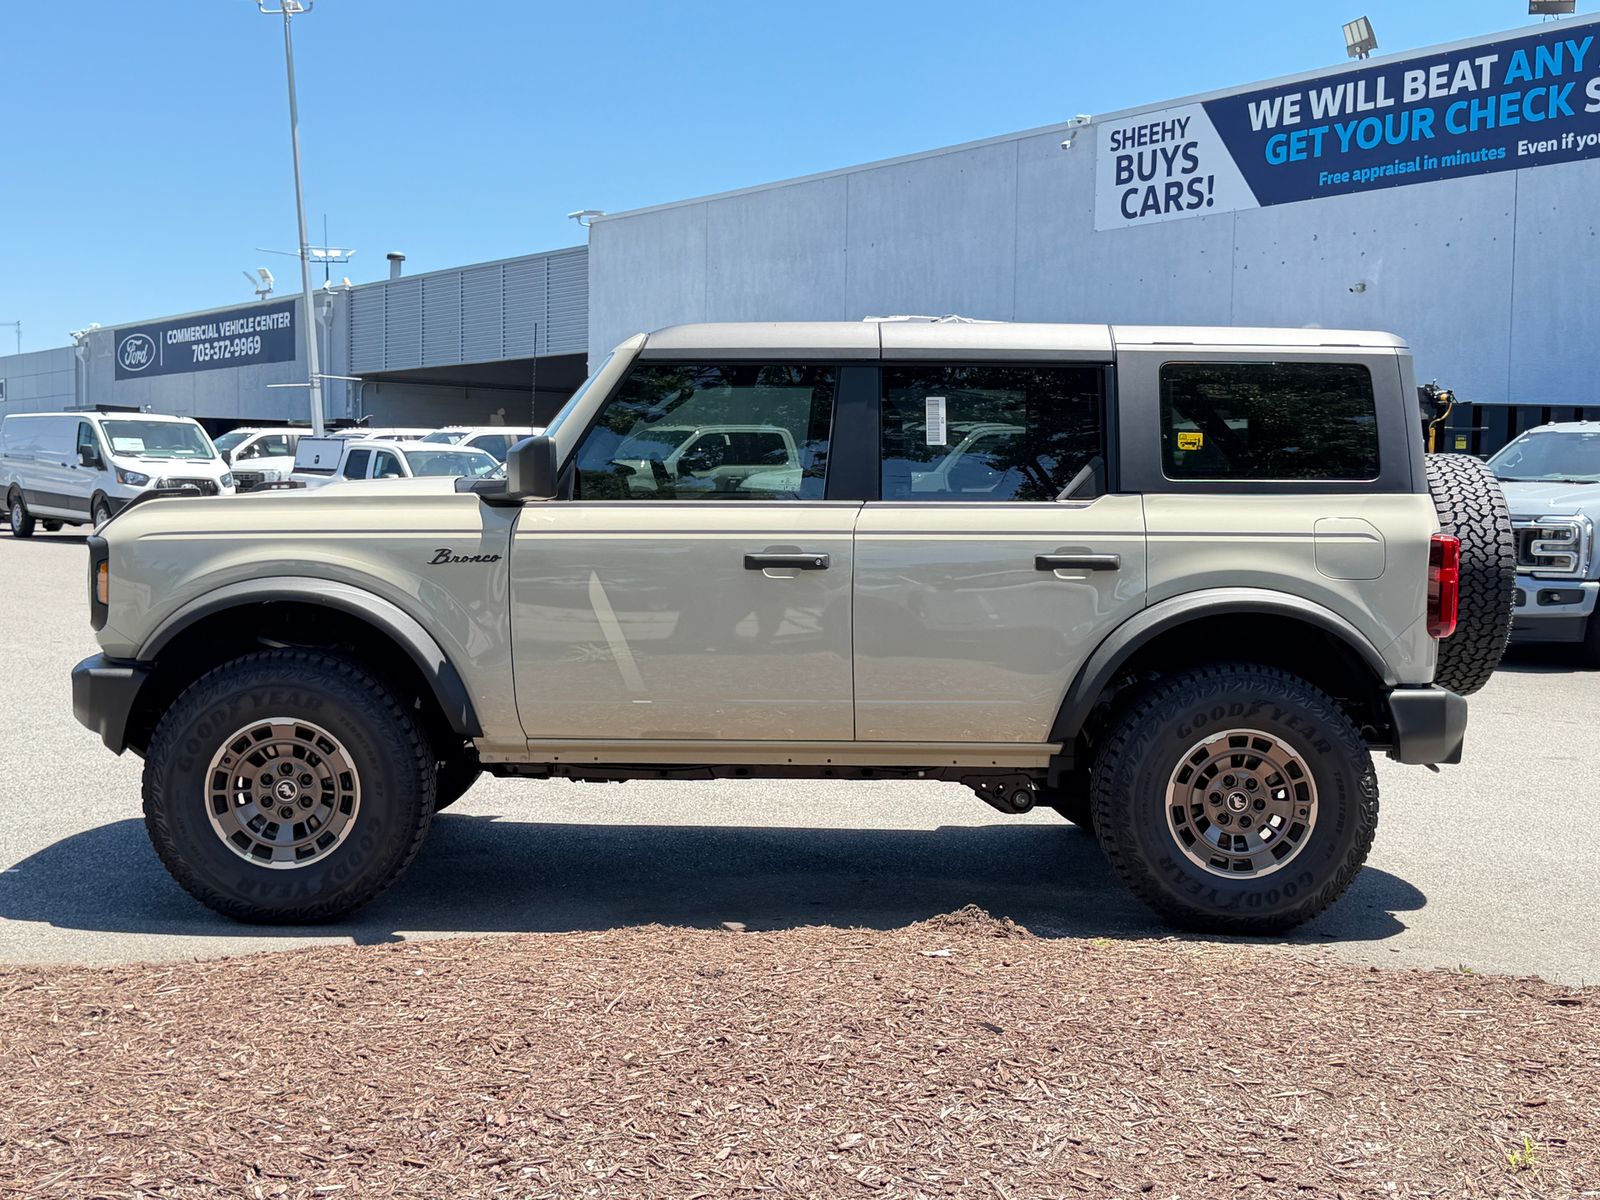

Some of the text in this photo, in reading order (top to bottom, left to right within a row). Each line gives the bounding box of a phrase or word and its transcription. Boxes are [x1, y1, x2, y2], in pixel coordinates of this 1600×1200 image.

[1248, 36, 1594, 131] WE WILL BEAT ANY
[1110, 116, 1191, 152] SHEEHY
[1265, 125, 1329, 166] GET
[1334, 106, 1435, 154] YOUR
[1444, 82, 1576, 135] CHECK
[1517, 132, 1600, 156] Even if yo
[1115, 141, 1199, 186] BUYS
[1318, 145, 1506, 187] Free appraisal in minutes
[1120, 175, 1215, 219] CARS!
[167, 312, 290, 345] COMMERCIAL VEHICLE CENTER
[124, 339, 148, 366] Ford
[192, 336, 261, 362] 703-372-9969
[427, 548, 502, 565] Bronco
